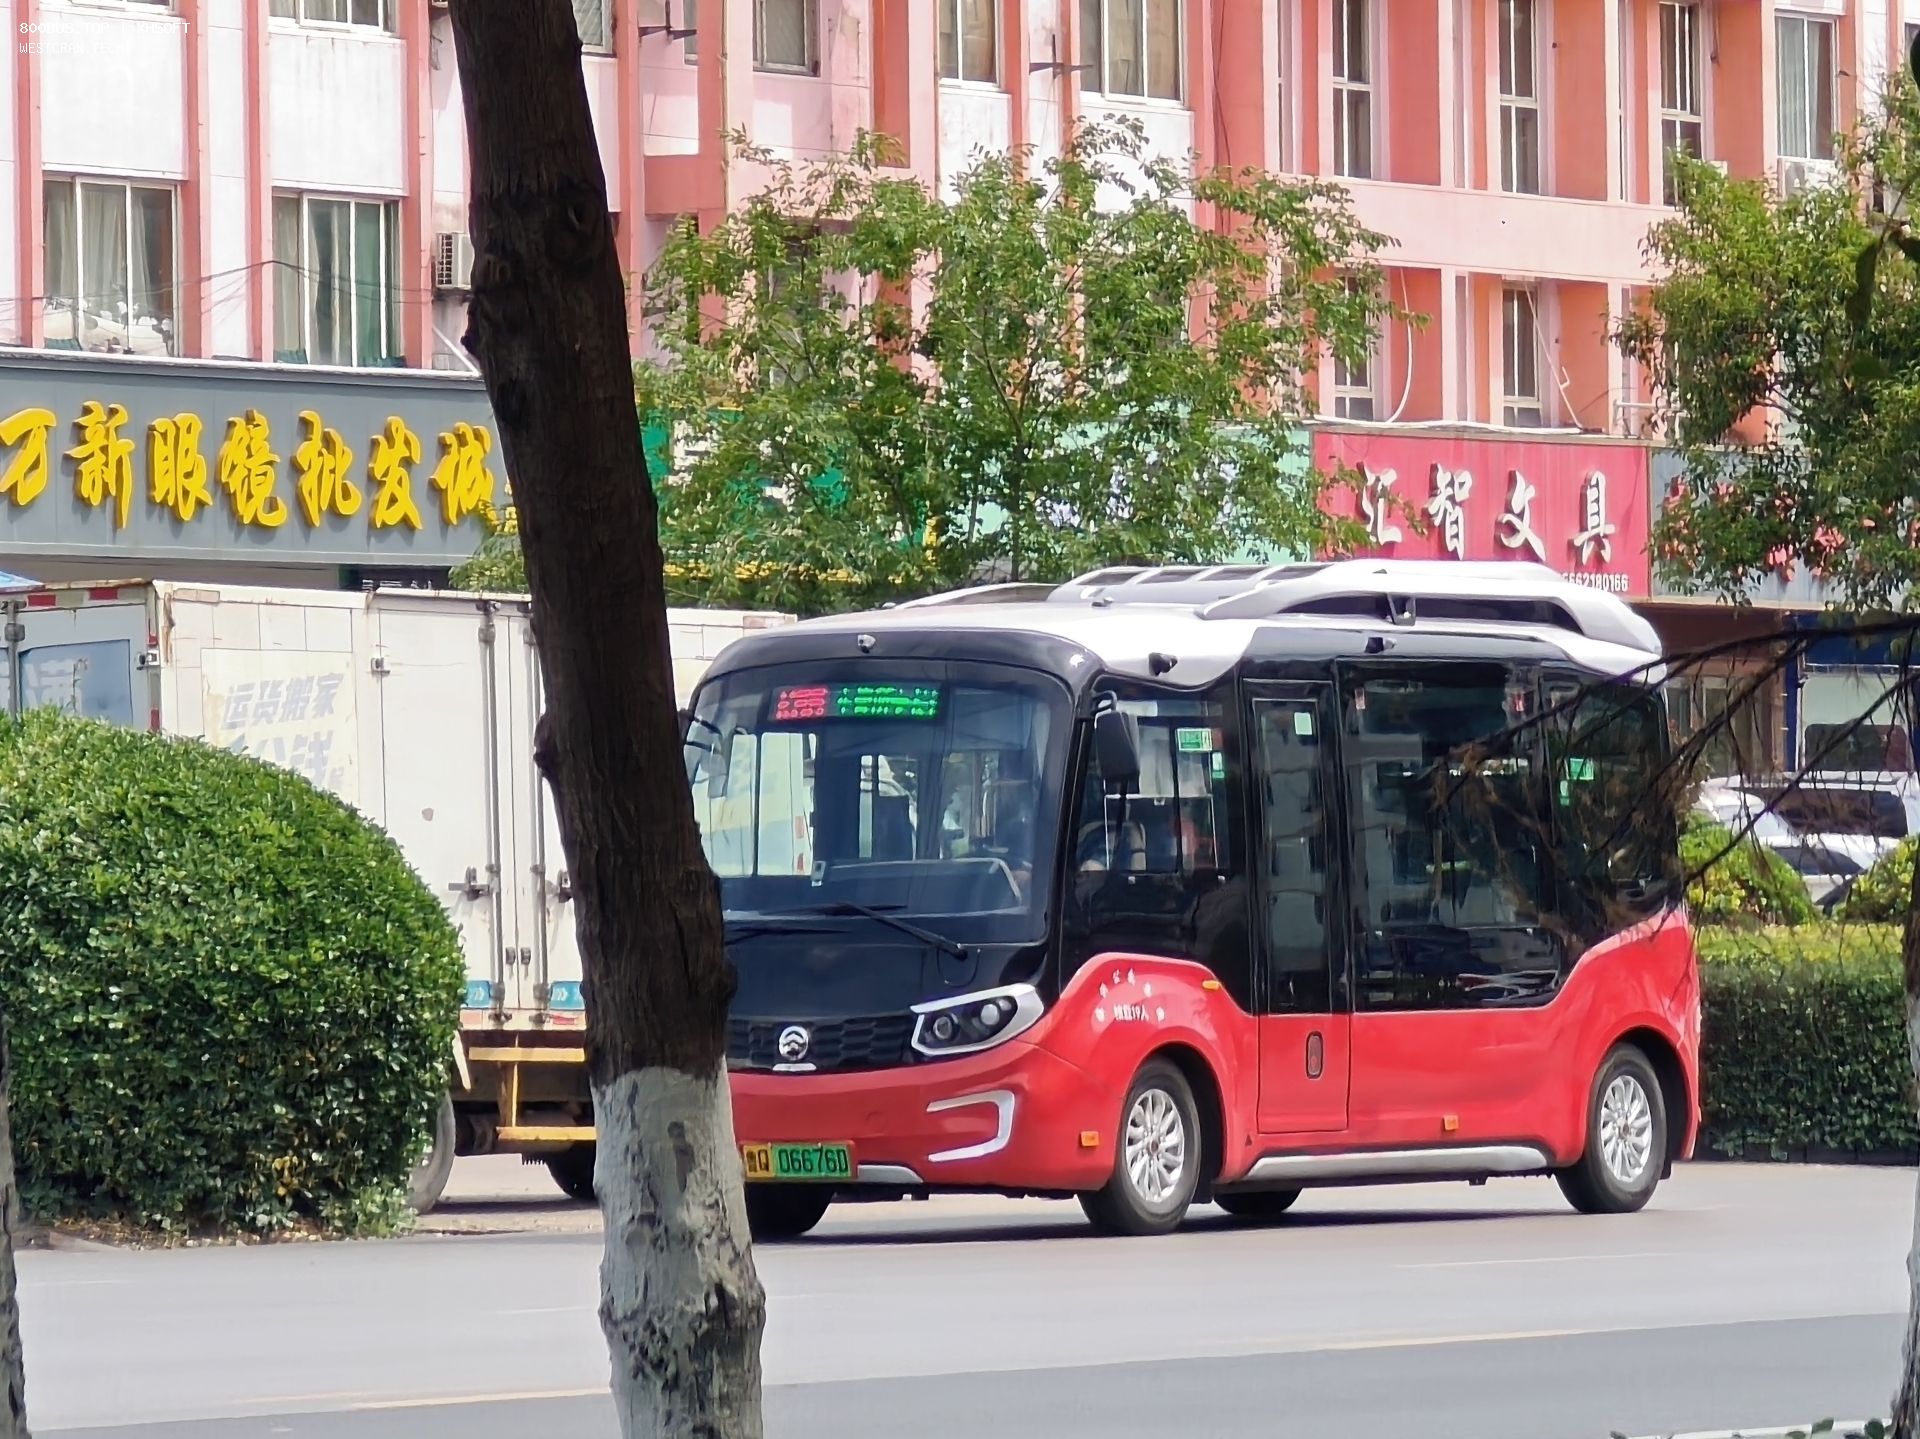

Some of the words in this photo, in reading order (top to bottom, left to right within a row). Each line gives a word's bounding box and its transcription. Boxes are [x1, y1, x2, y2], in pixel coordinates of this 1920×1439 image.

[0, 400, 498, 530] 万新眼镜批发城
[1360, 462, 1616, 566] 汇智文具
[219, 671, 345, 730] 运货搬家
